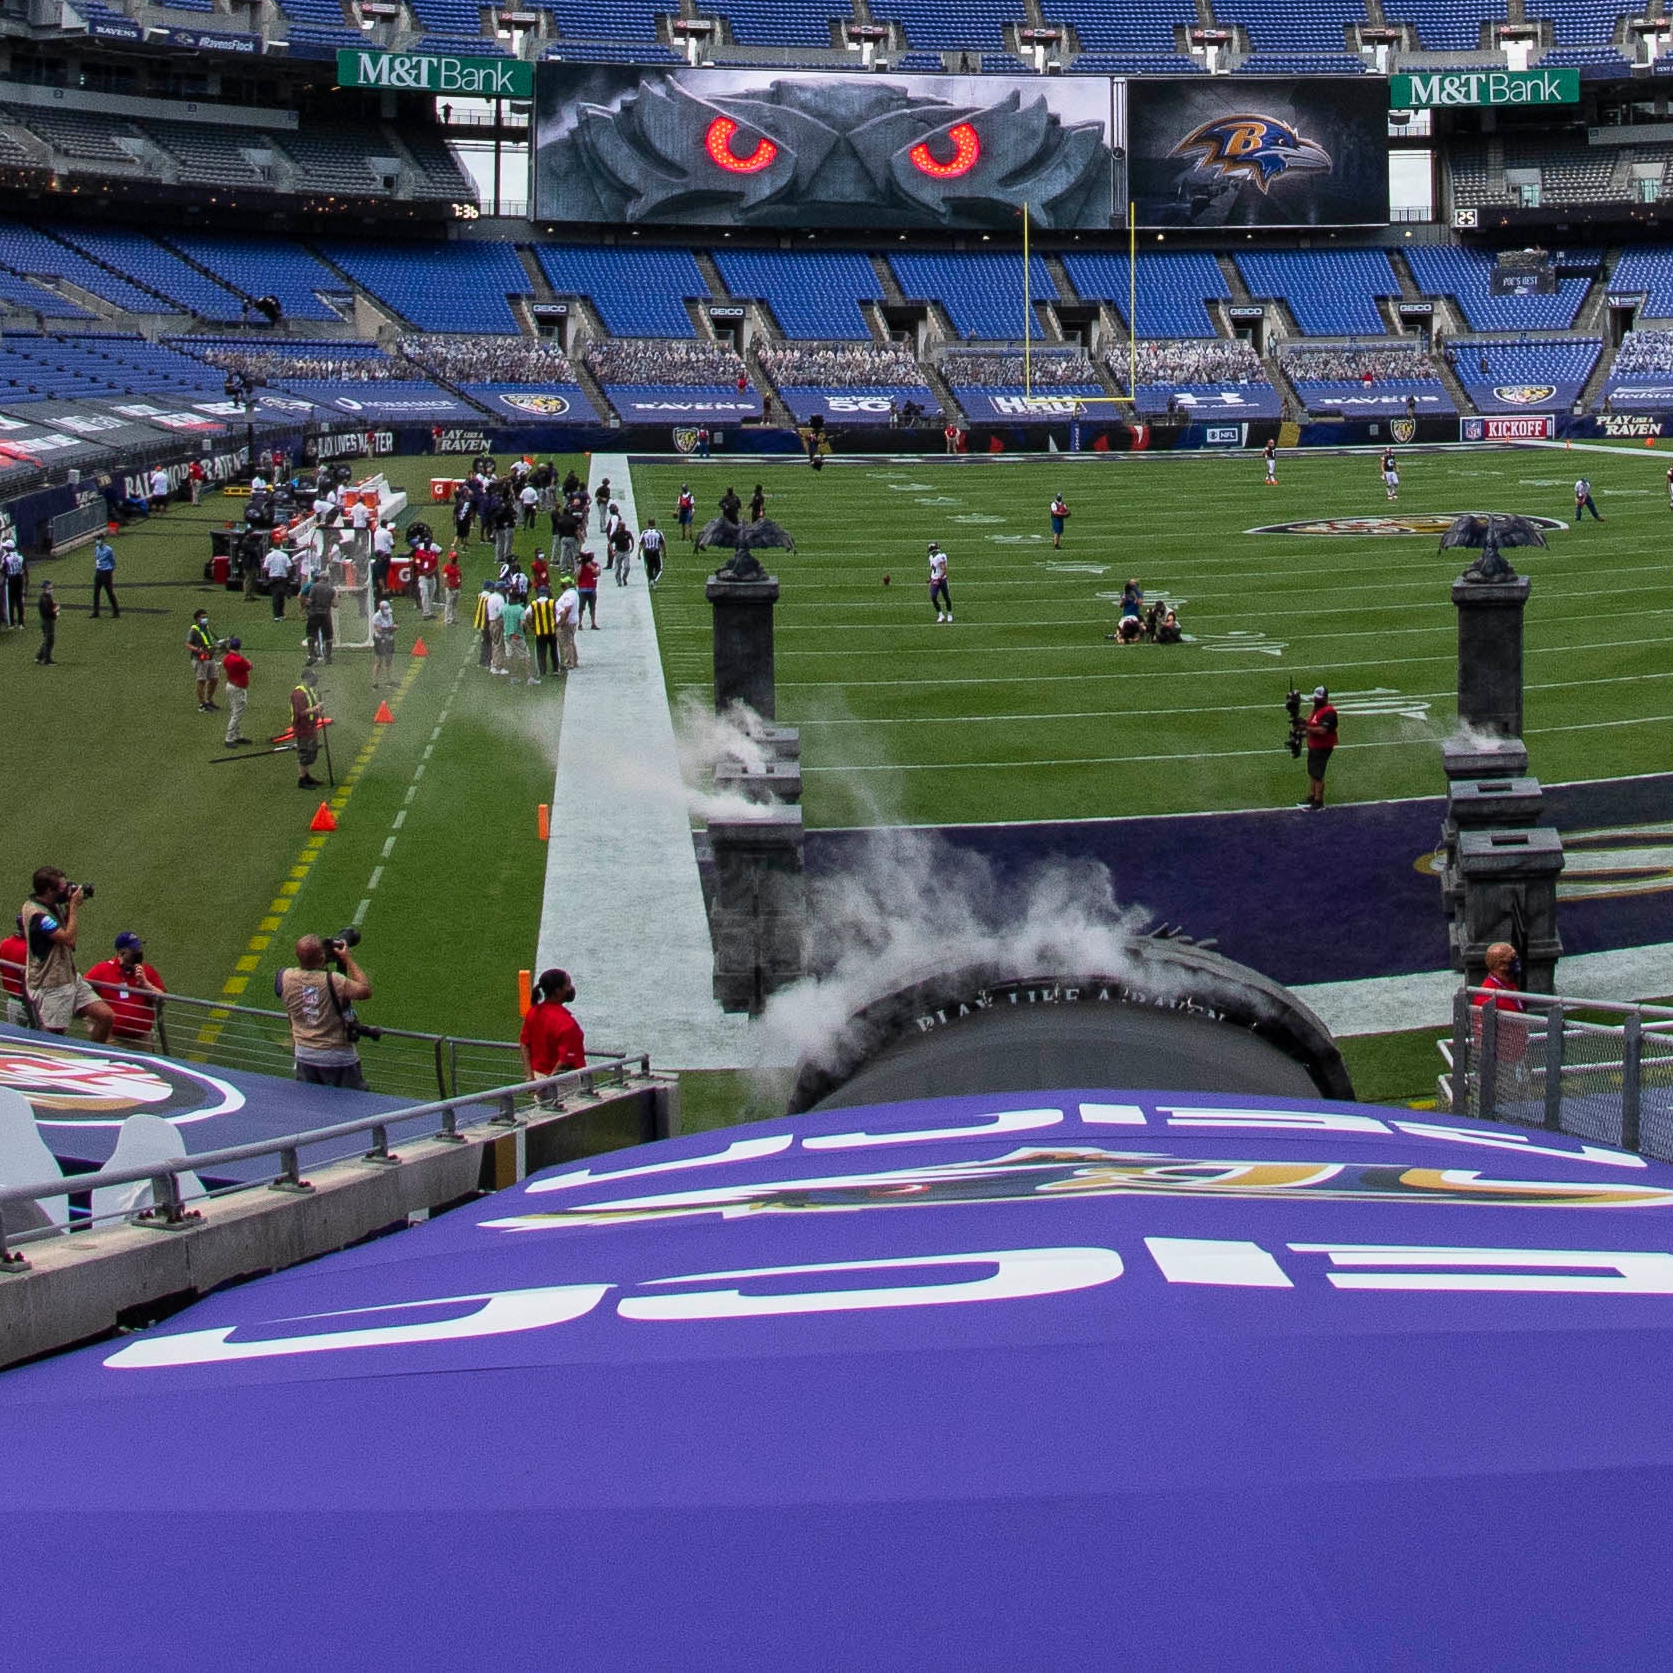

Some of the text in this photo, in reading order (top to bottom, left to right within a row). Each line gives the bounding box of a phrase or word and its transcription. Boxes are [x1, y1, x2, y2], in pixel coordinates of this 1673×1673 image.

[95, 26, 138, 39] RAVENS
[198, 36, 255, 53] #RavensFlock
[357, 52, 515, 93] M&T Bank
[1409, 72, 1562, 105] M&T Bank
[1223, 122, 1267, 155] B
[1458, 211, 1475, 224] 25
[532, 303, 568, 314] GEICO
[709, 306, 744, 316] GEICO
[1229, 307, 1263, 316] GEICO
[1399, 303, 1432, 313] GEICO
[824, 395, 892, 403] verizon
[630, 401, 758, 412] RAVENS
[829, 399, 893, 413] 5G
[1596, 415, 1633, 426] PLAY
[441, 429, 463, 440] LAY
[1220, 430, 1235, 439] NFL
[1488, 420, 1543, 437] KICKOFF
[1605, 423, 1664, 437] RAVEN
[334, 433, 357, 454] LIVES
[440, 438, 493, 454] RAVEN
